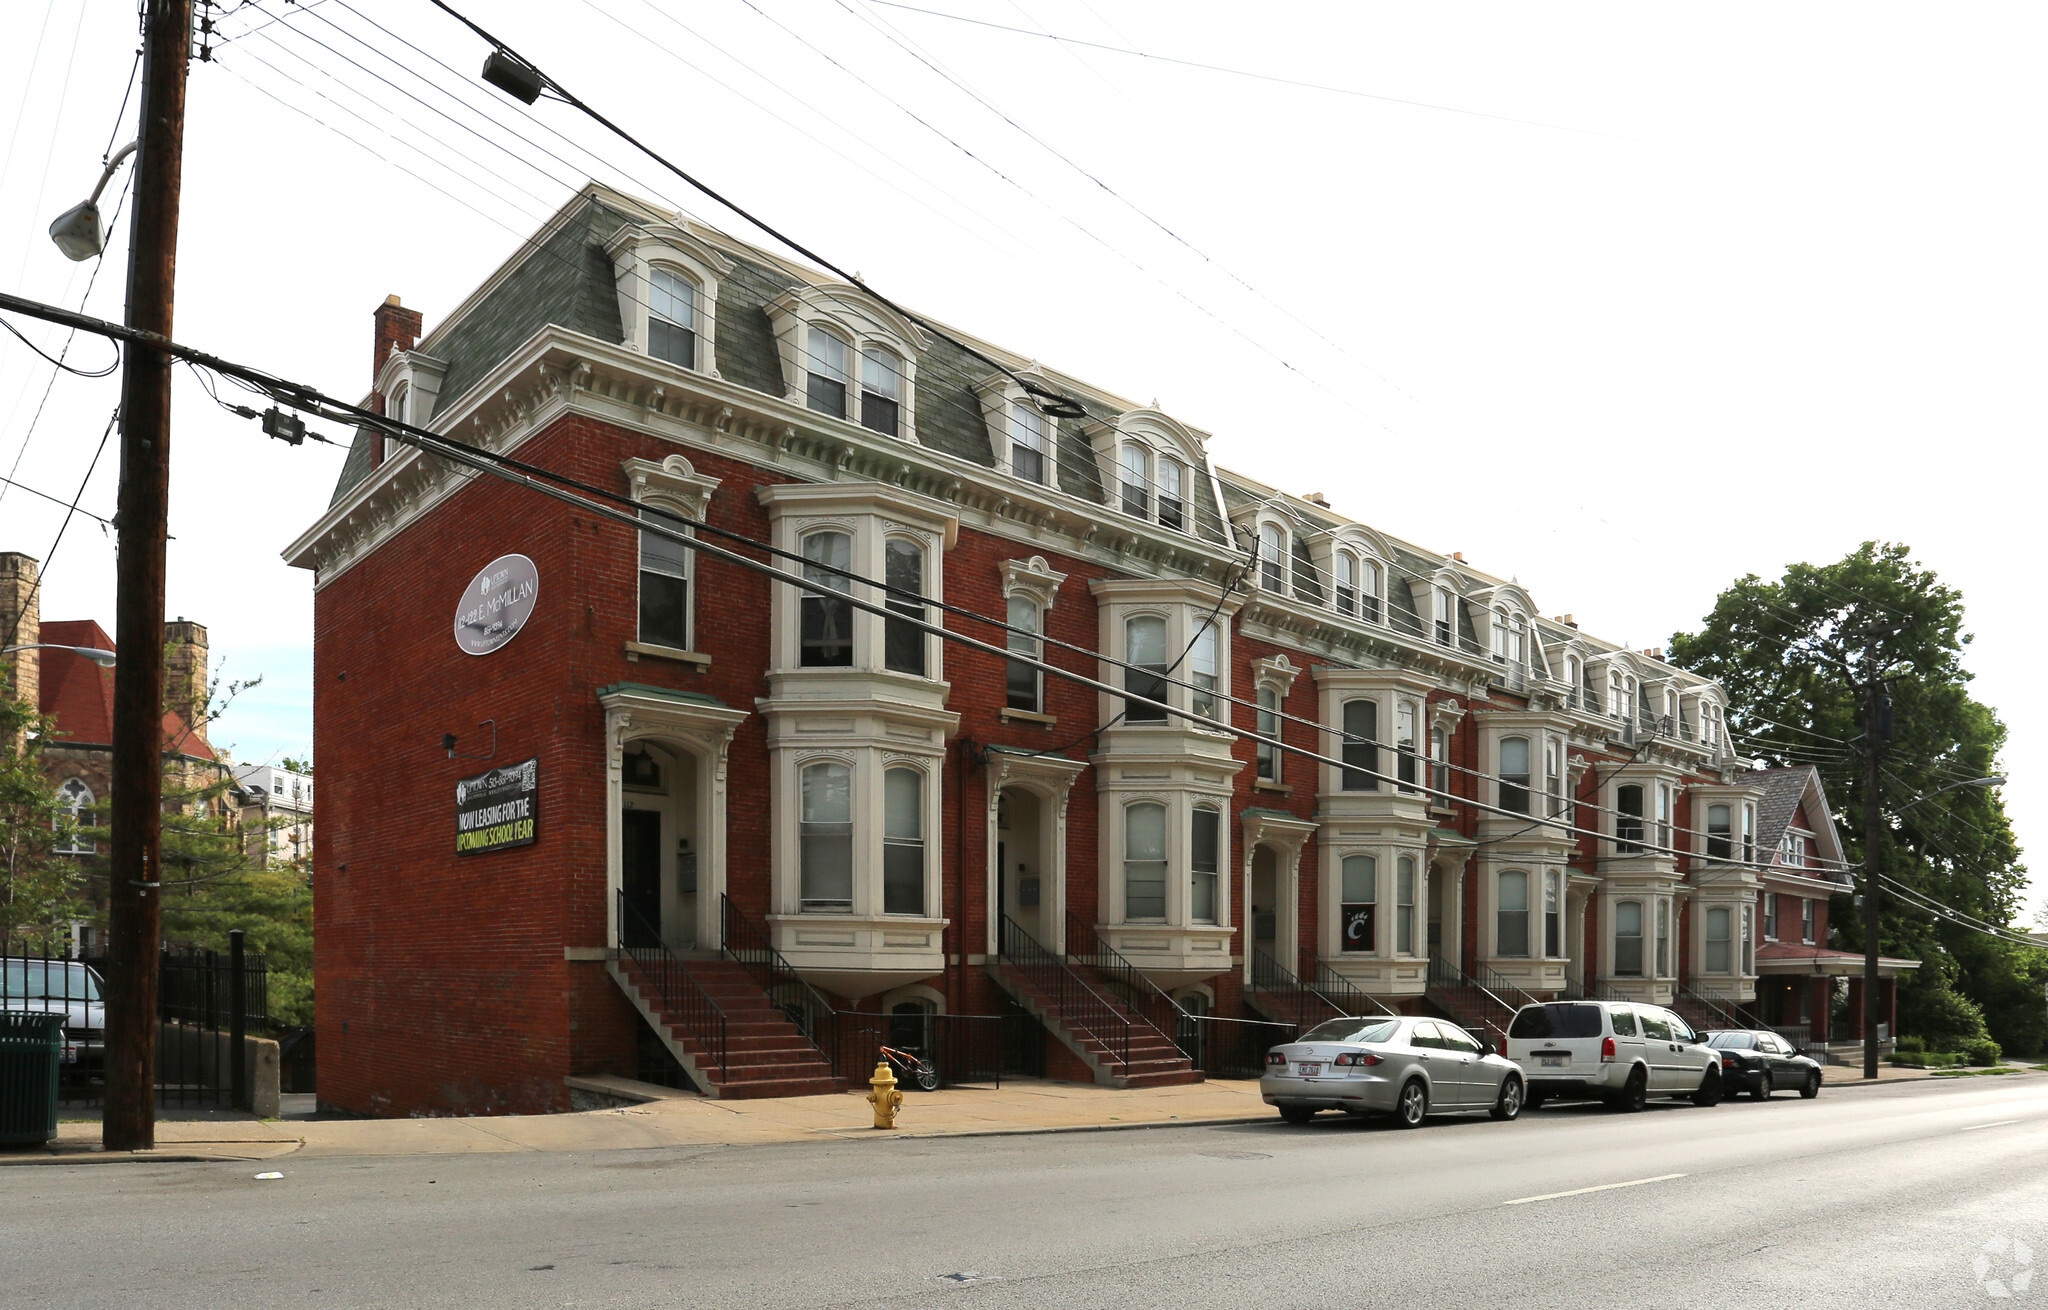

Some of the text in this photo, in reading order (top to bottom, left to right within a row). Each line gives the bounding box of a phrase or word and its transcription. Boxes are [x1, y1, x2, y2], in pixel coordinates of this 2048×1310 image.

[486, 578, 533, 616] McMILLAN
[459, 797, 530, 831] NOW LEASING FOR THE
[457, 818, 534, 851] UPCOMING SCHOOL YEAR
